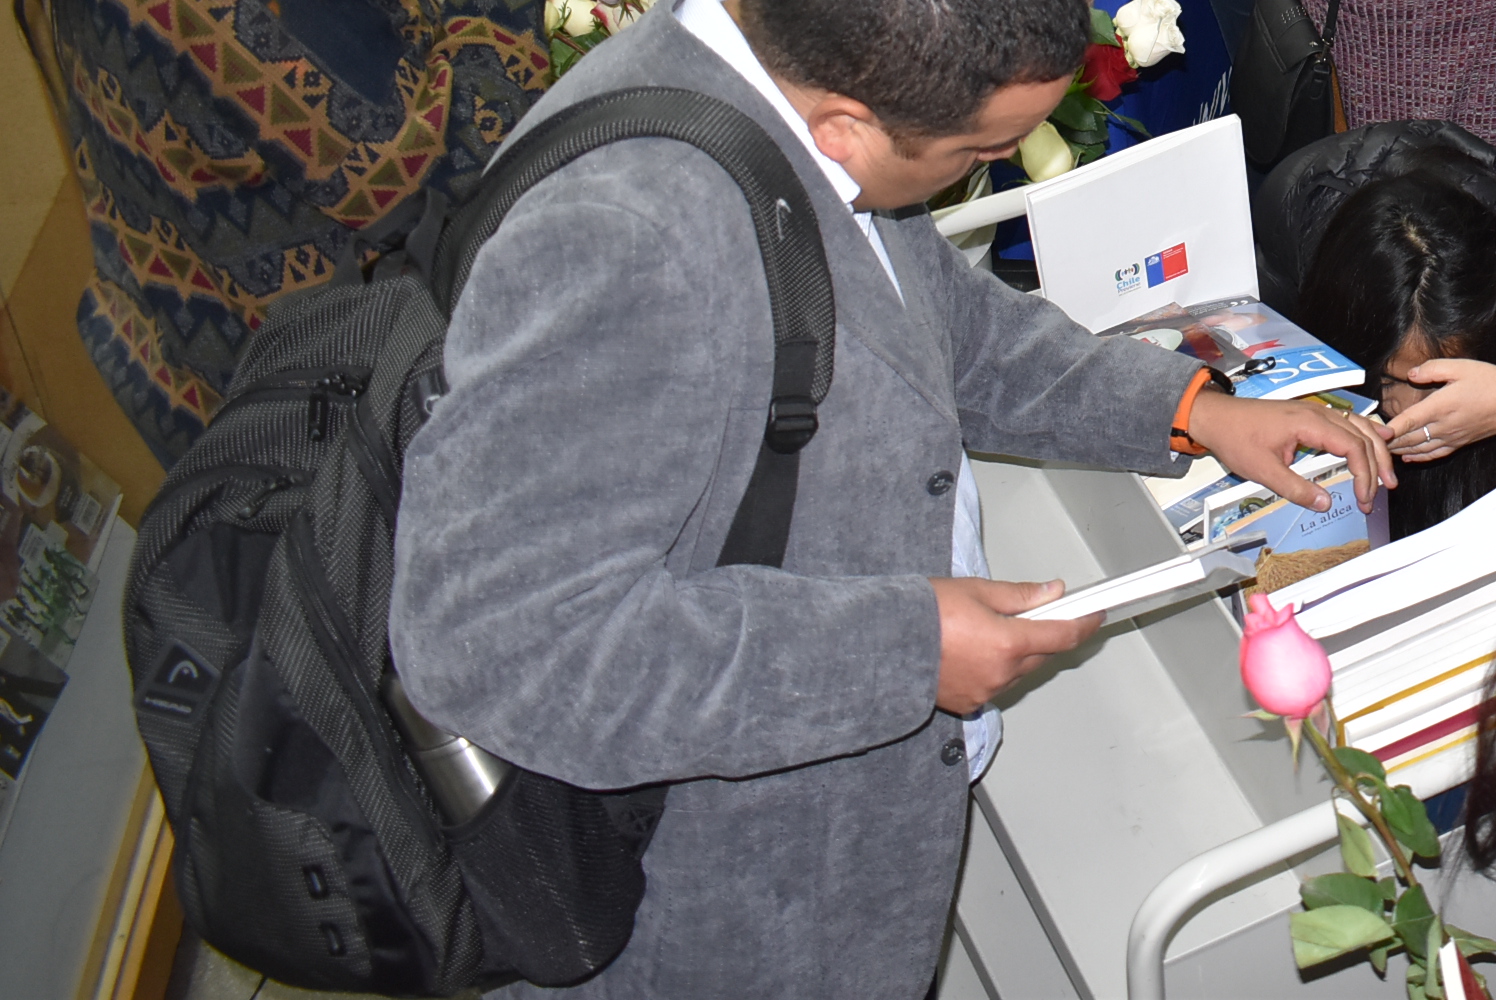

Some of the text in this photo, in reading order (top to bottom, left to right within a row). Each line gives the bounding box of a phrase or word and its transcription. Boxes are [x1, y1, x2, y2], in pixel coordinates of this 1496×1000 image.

[1116, 275, 1141, 290] Chile
[1300, 520, 1316, 532] La
[1320, 504, 1353, 523] aldea
